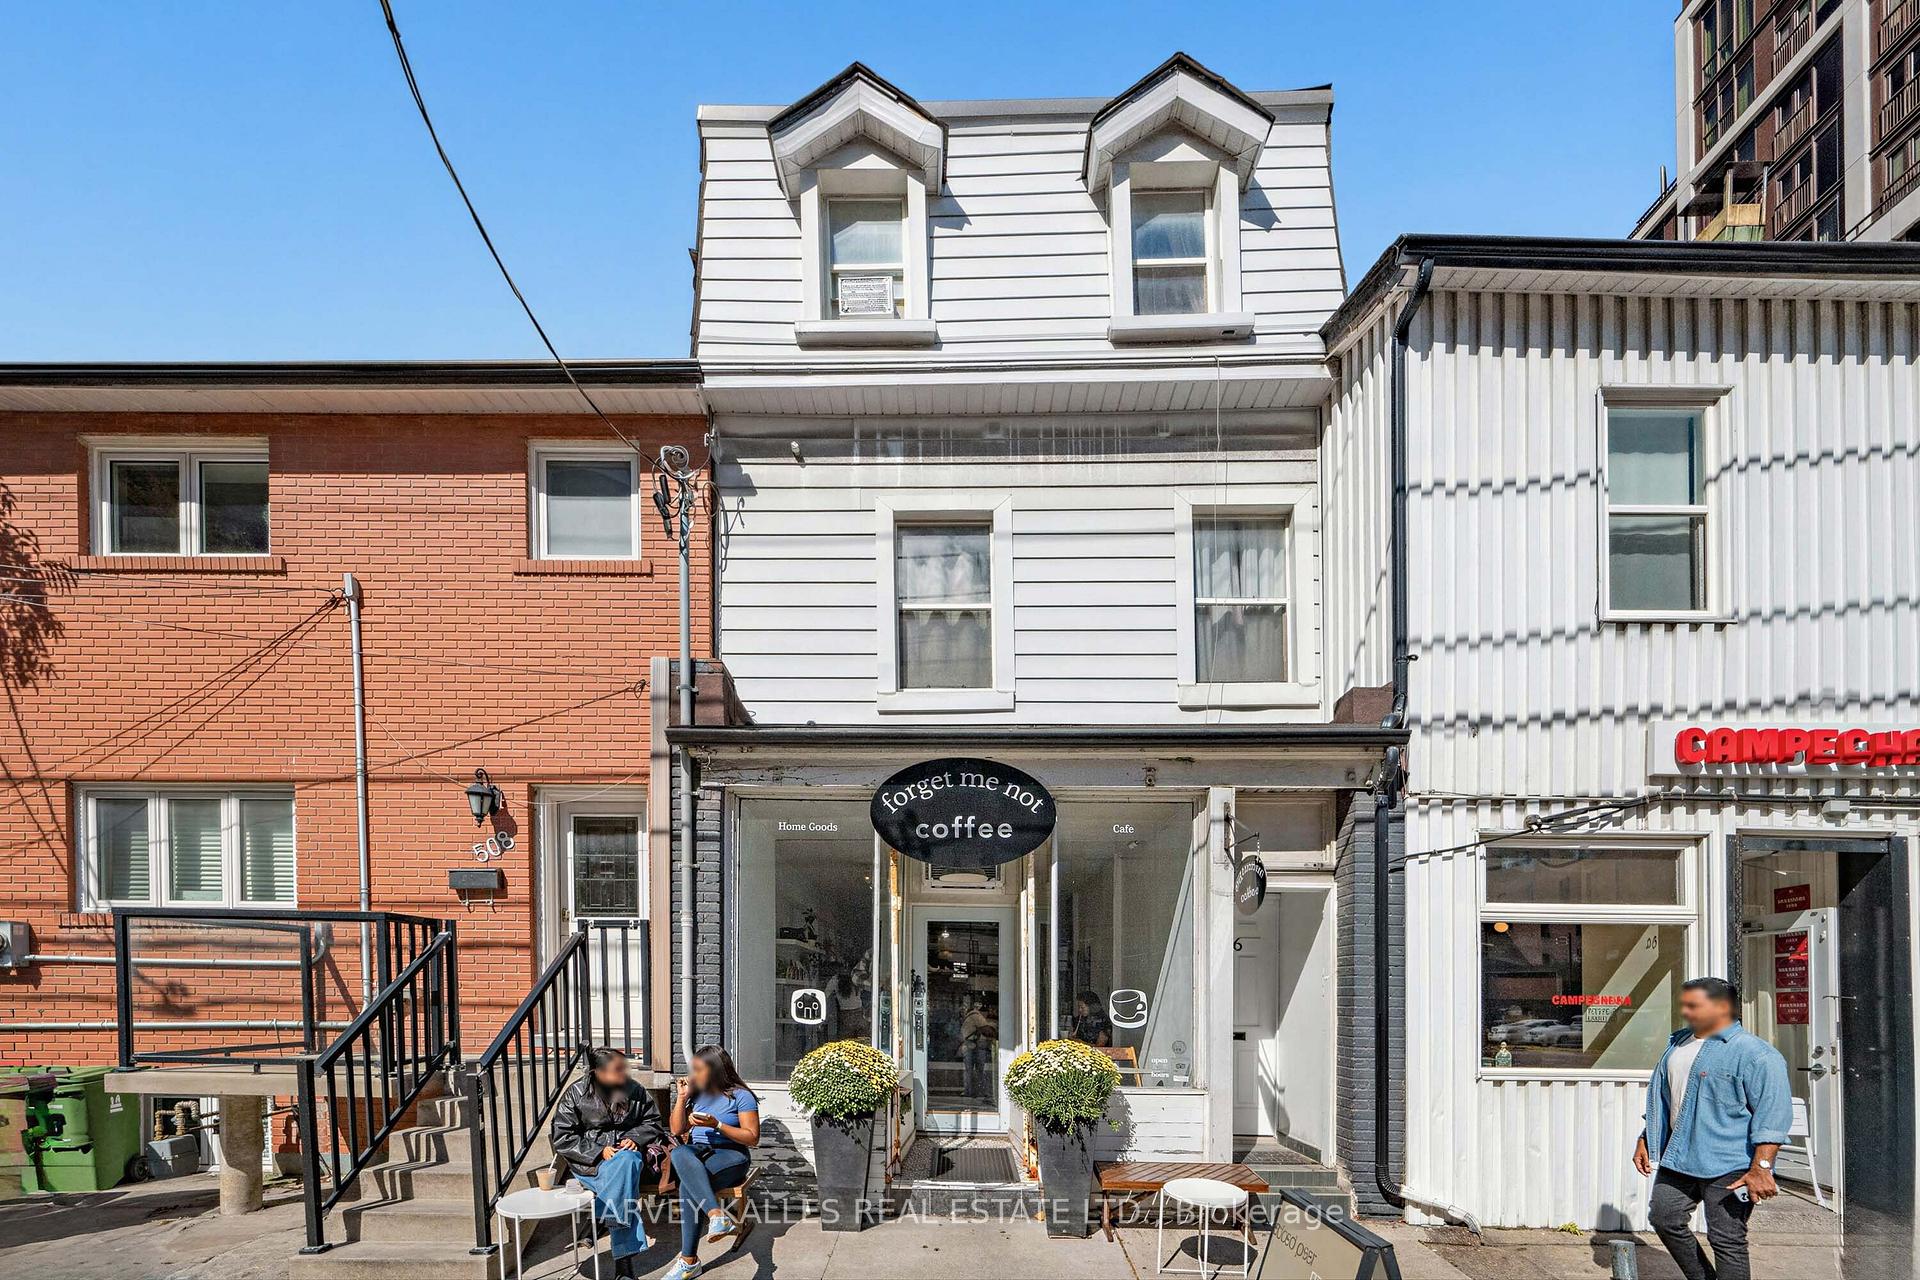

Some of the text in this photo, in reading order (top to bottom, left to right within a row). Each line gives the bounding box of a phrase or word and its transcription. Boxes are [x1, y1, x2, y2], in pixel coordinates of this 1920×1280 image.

[881, 771, 1045, 815] forget me not
[778, 821, 838, 832] Home Goods
[915, 815, 1013, 839] coffee
[1113, 824, 1135, 834] Cafe
[472, 831, 515, 862] 508
